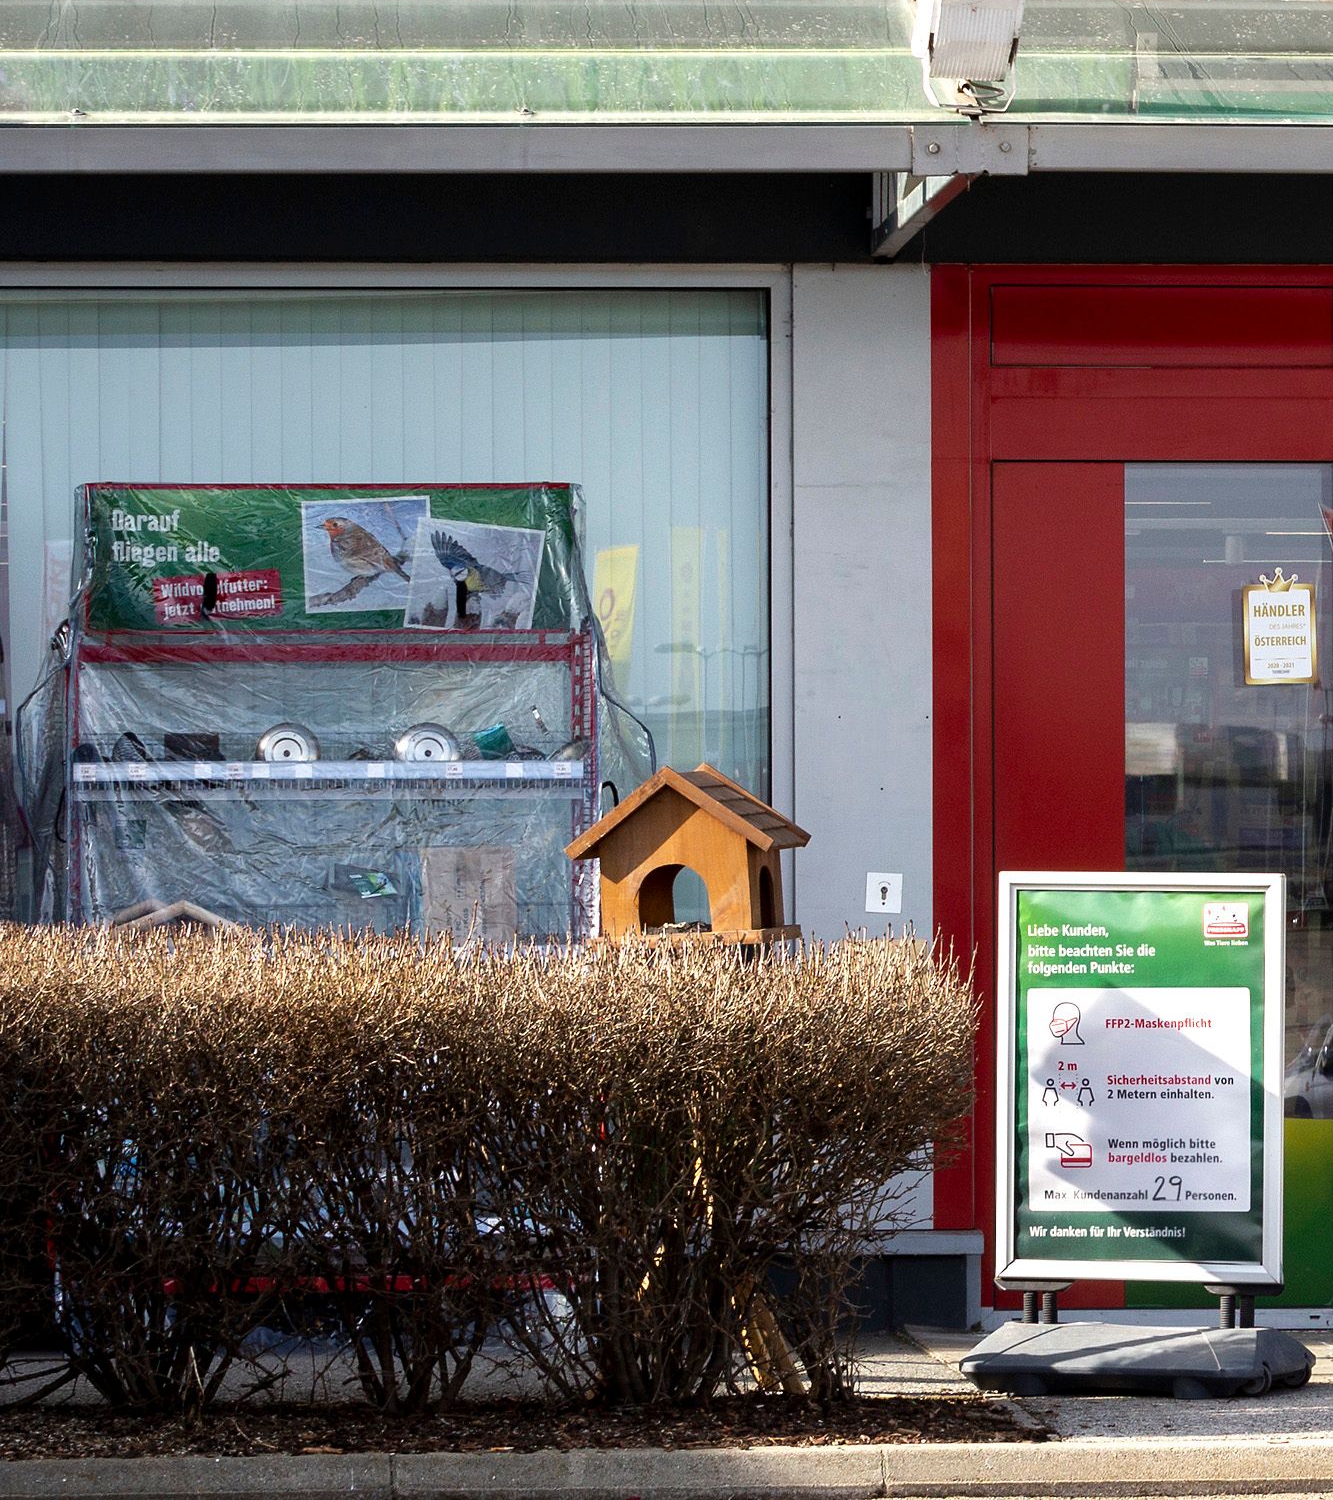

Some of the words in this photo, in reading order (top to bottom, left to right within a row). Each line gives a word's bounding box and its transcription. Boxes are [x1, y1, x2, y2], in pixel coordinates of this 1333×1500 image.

[112, 509, 180, 532] Darauf
[112, 541, 178, 567] fliegen
[185, 541, 220, 563] alle
[161, 578, 268, 598] Wildvolfutter:
[163, 602, 195, 621] jetzt
[1253, 603, 1305, 617] HÄNDLER
[1254, 635, 1306, 646] ÖSTERREICH
[1027, 924, 1059, 937] Liebe
[1062, 924, 1109, 939] Kunden,
[1028, 944, 1056, 957] bitte
[1058, 944, 1113, 957] beachten
[1116, 944, 1134, 957] Sie
[1136, 944, 1156, 957] die
[1027, 961, 1088, 977] folgenden
[1090, 961, 1135, 974] Punkte:
[1105, 1018, 1212, 1031] FFP2-Maskenpflicht
[1058, 1061, 1064, 1070] 2
[1107, 1075, 1212, 1086] Sicherheitsabstand
[1214, 1077, 1234, 1086] von
[1107, 1090, 1114, 1099] 2
[1117, 1089, 1157, 1100] Metern
[1160, 1089, 1214, 1100] einhalten.
[1108, 1139, 1139, 1149] Wenn
[1142, 1138, 1186, 1153] möglich
[1189, 1138, 1216, 1149] bitte
[1108, 1153, 1167, 1166] bargeldlos
[1170, 1153, 1223, 1164] bezahlen.
[1073, 1189, 1148, 1200] Kundenanzahl
[1152, 1176, 1183, 1202] 29
[1185, 1190, 1237, 1201] Personen.
[1029, 1226, 1048, 1238] Wir
[1050, 1226, 1088, 1238] danken
[1090, 1226, 1105, 1238] für
[1107, 1226, 1121, 1238] Ihr
[1123, 1226, 1186, 1238] Verständnis!
